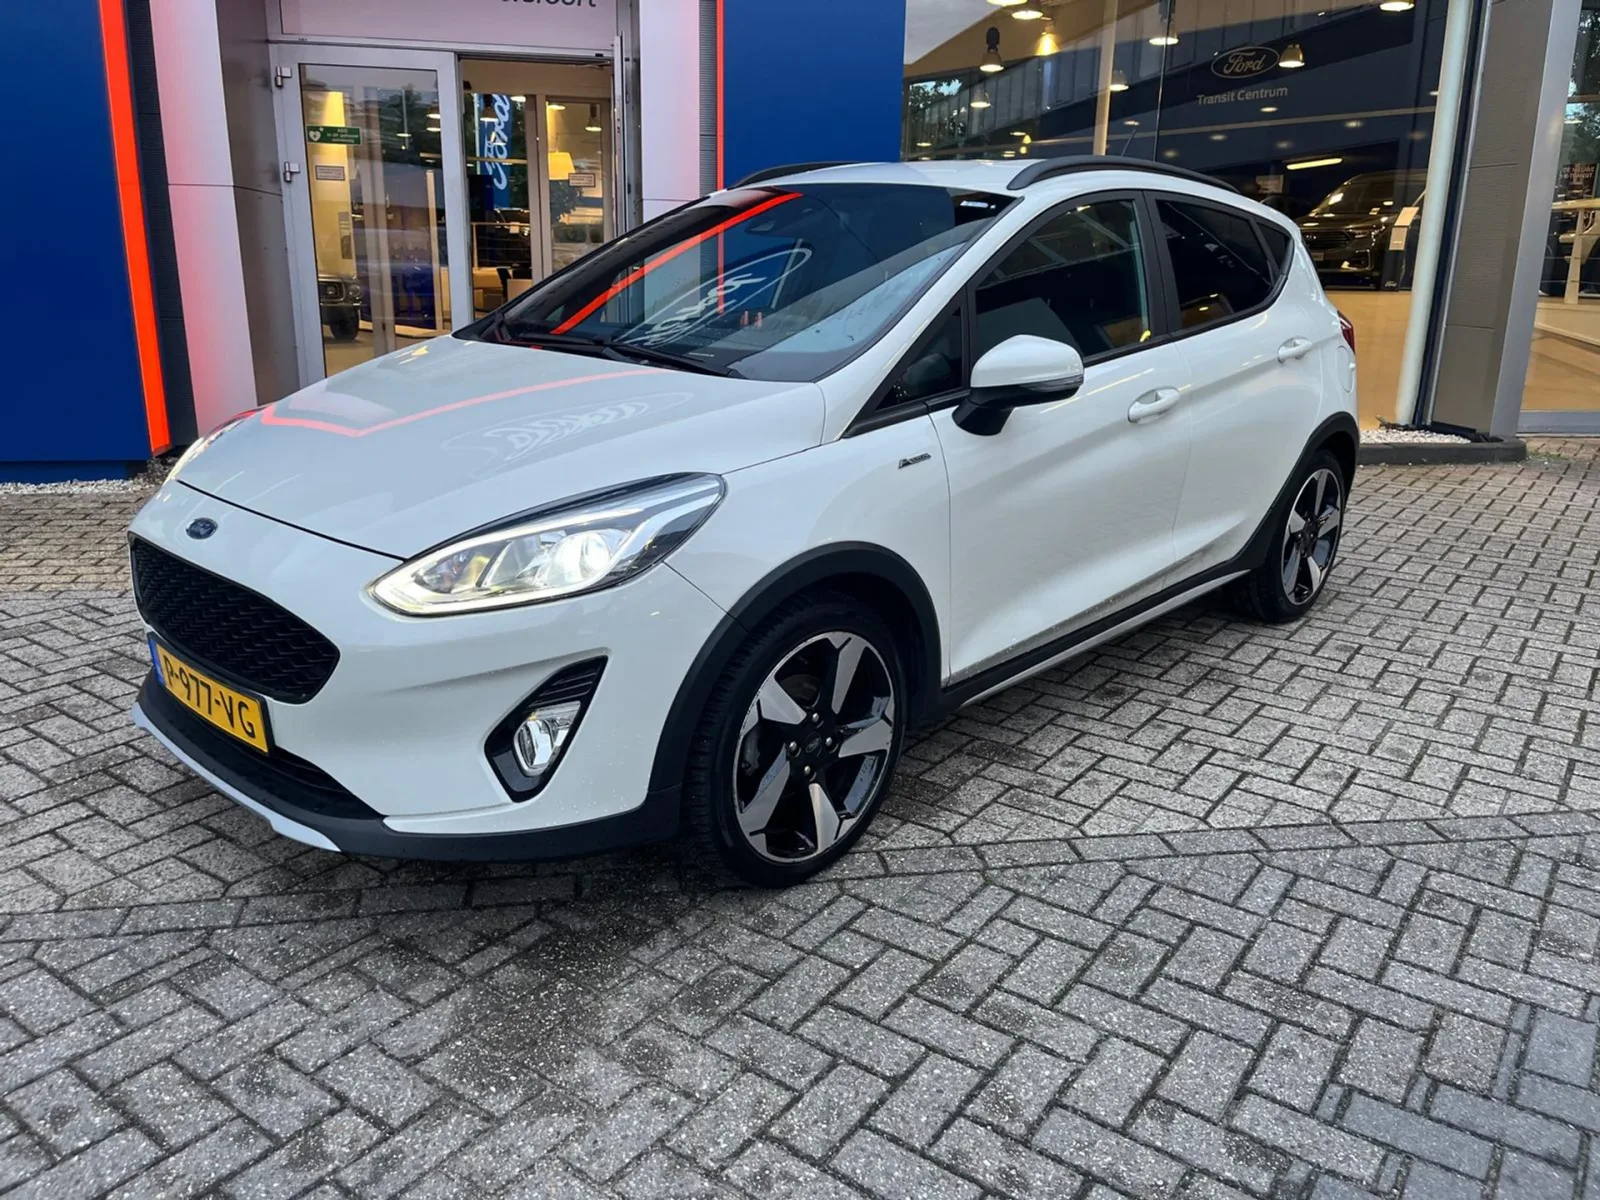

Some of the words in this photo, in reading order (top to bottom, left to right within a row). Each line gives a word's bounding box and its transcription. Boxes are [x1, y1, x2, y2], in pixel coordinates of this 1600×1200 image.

[1223, 51, 1266, 74] Ford
[1196, 91, 1235, 105] Transit
[1237, 87, 1288, 101] Centrum
[163, 654, 257, 739] P-977-VG
